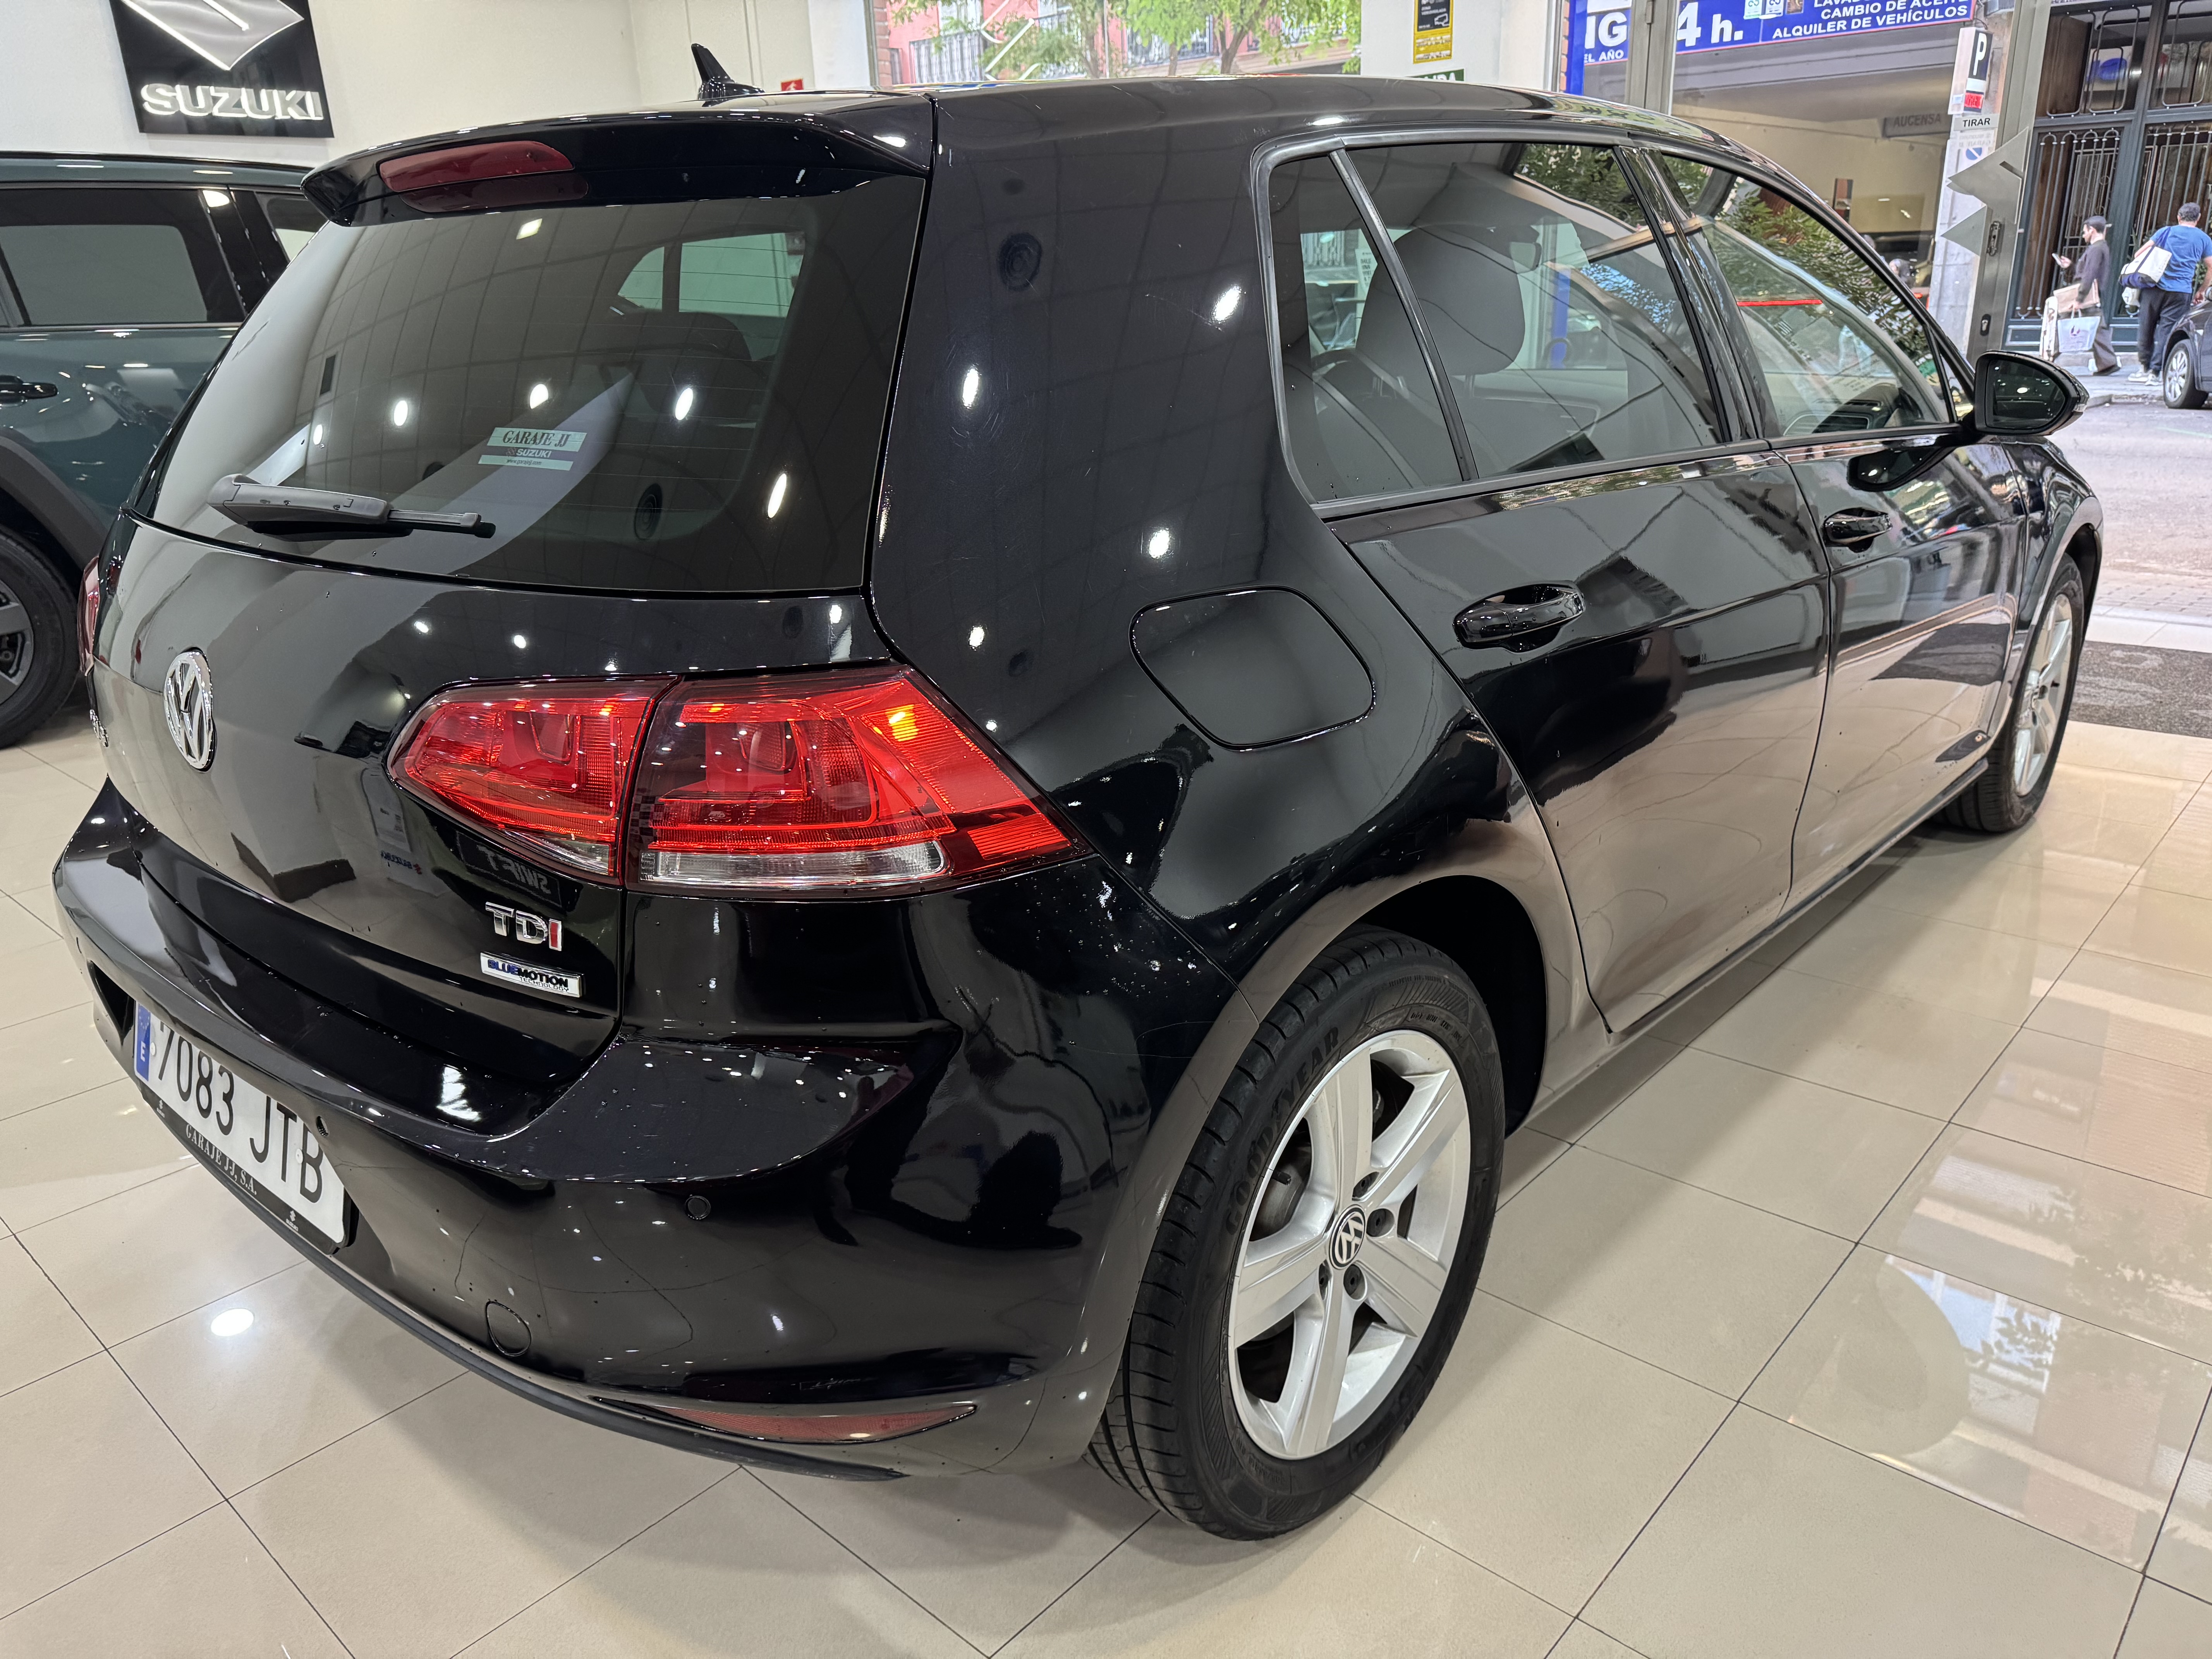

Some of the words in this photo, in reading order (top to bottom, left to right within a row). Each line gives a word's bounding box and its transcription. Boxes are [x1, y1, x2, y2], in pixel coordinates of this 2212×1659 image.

[1772, 20, 1846, 39] ALQUILER
[1851, 17, 1872, 29] DE
[1876, 5, 1967, 26] VEHÍCULOS
[1821, 3, 1881, 19] CAMBIO
[1886, 1, 1906, 12] DE
[1711, 14, 1743, 43] h.
[1599, 49, 1624, 62] AÑO
[1973, 33, 1987, 76] P
[141, 82, 324, 120] SUZUKI
[1963, 118, 1990, 127] TIRAR
[502, 430, 555, 446] GARAJE
[555, 434, 571, 447] JJ
[516, 448, 552, 458] SUZUKI
[485, 902, 562, 951] TDI
[488, 959, 568, 988] BLUEMOTION
[519, 977, 569, 992] TECHNOLOGY
[140, 1041, 146, 1061] E
[158, 1021, 234, 1135] 7083
[249, 1095, 323, 1204] JTB
[1226, 1026, 1339, 1235] GOODYEAR
[186, 1124, 222, 1165] GARAJE
[240, 1170, 257, 1195] S.A.
